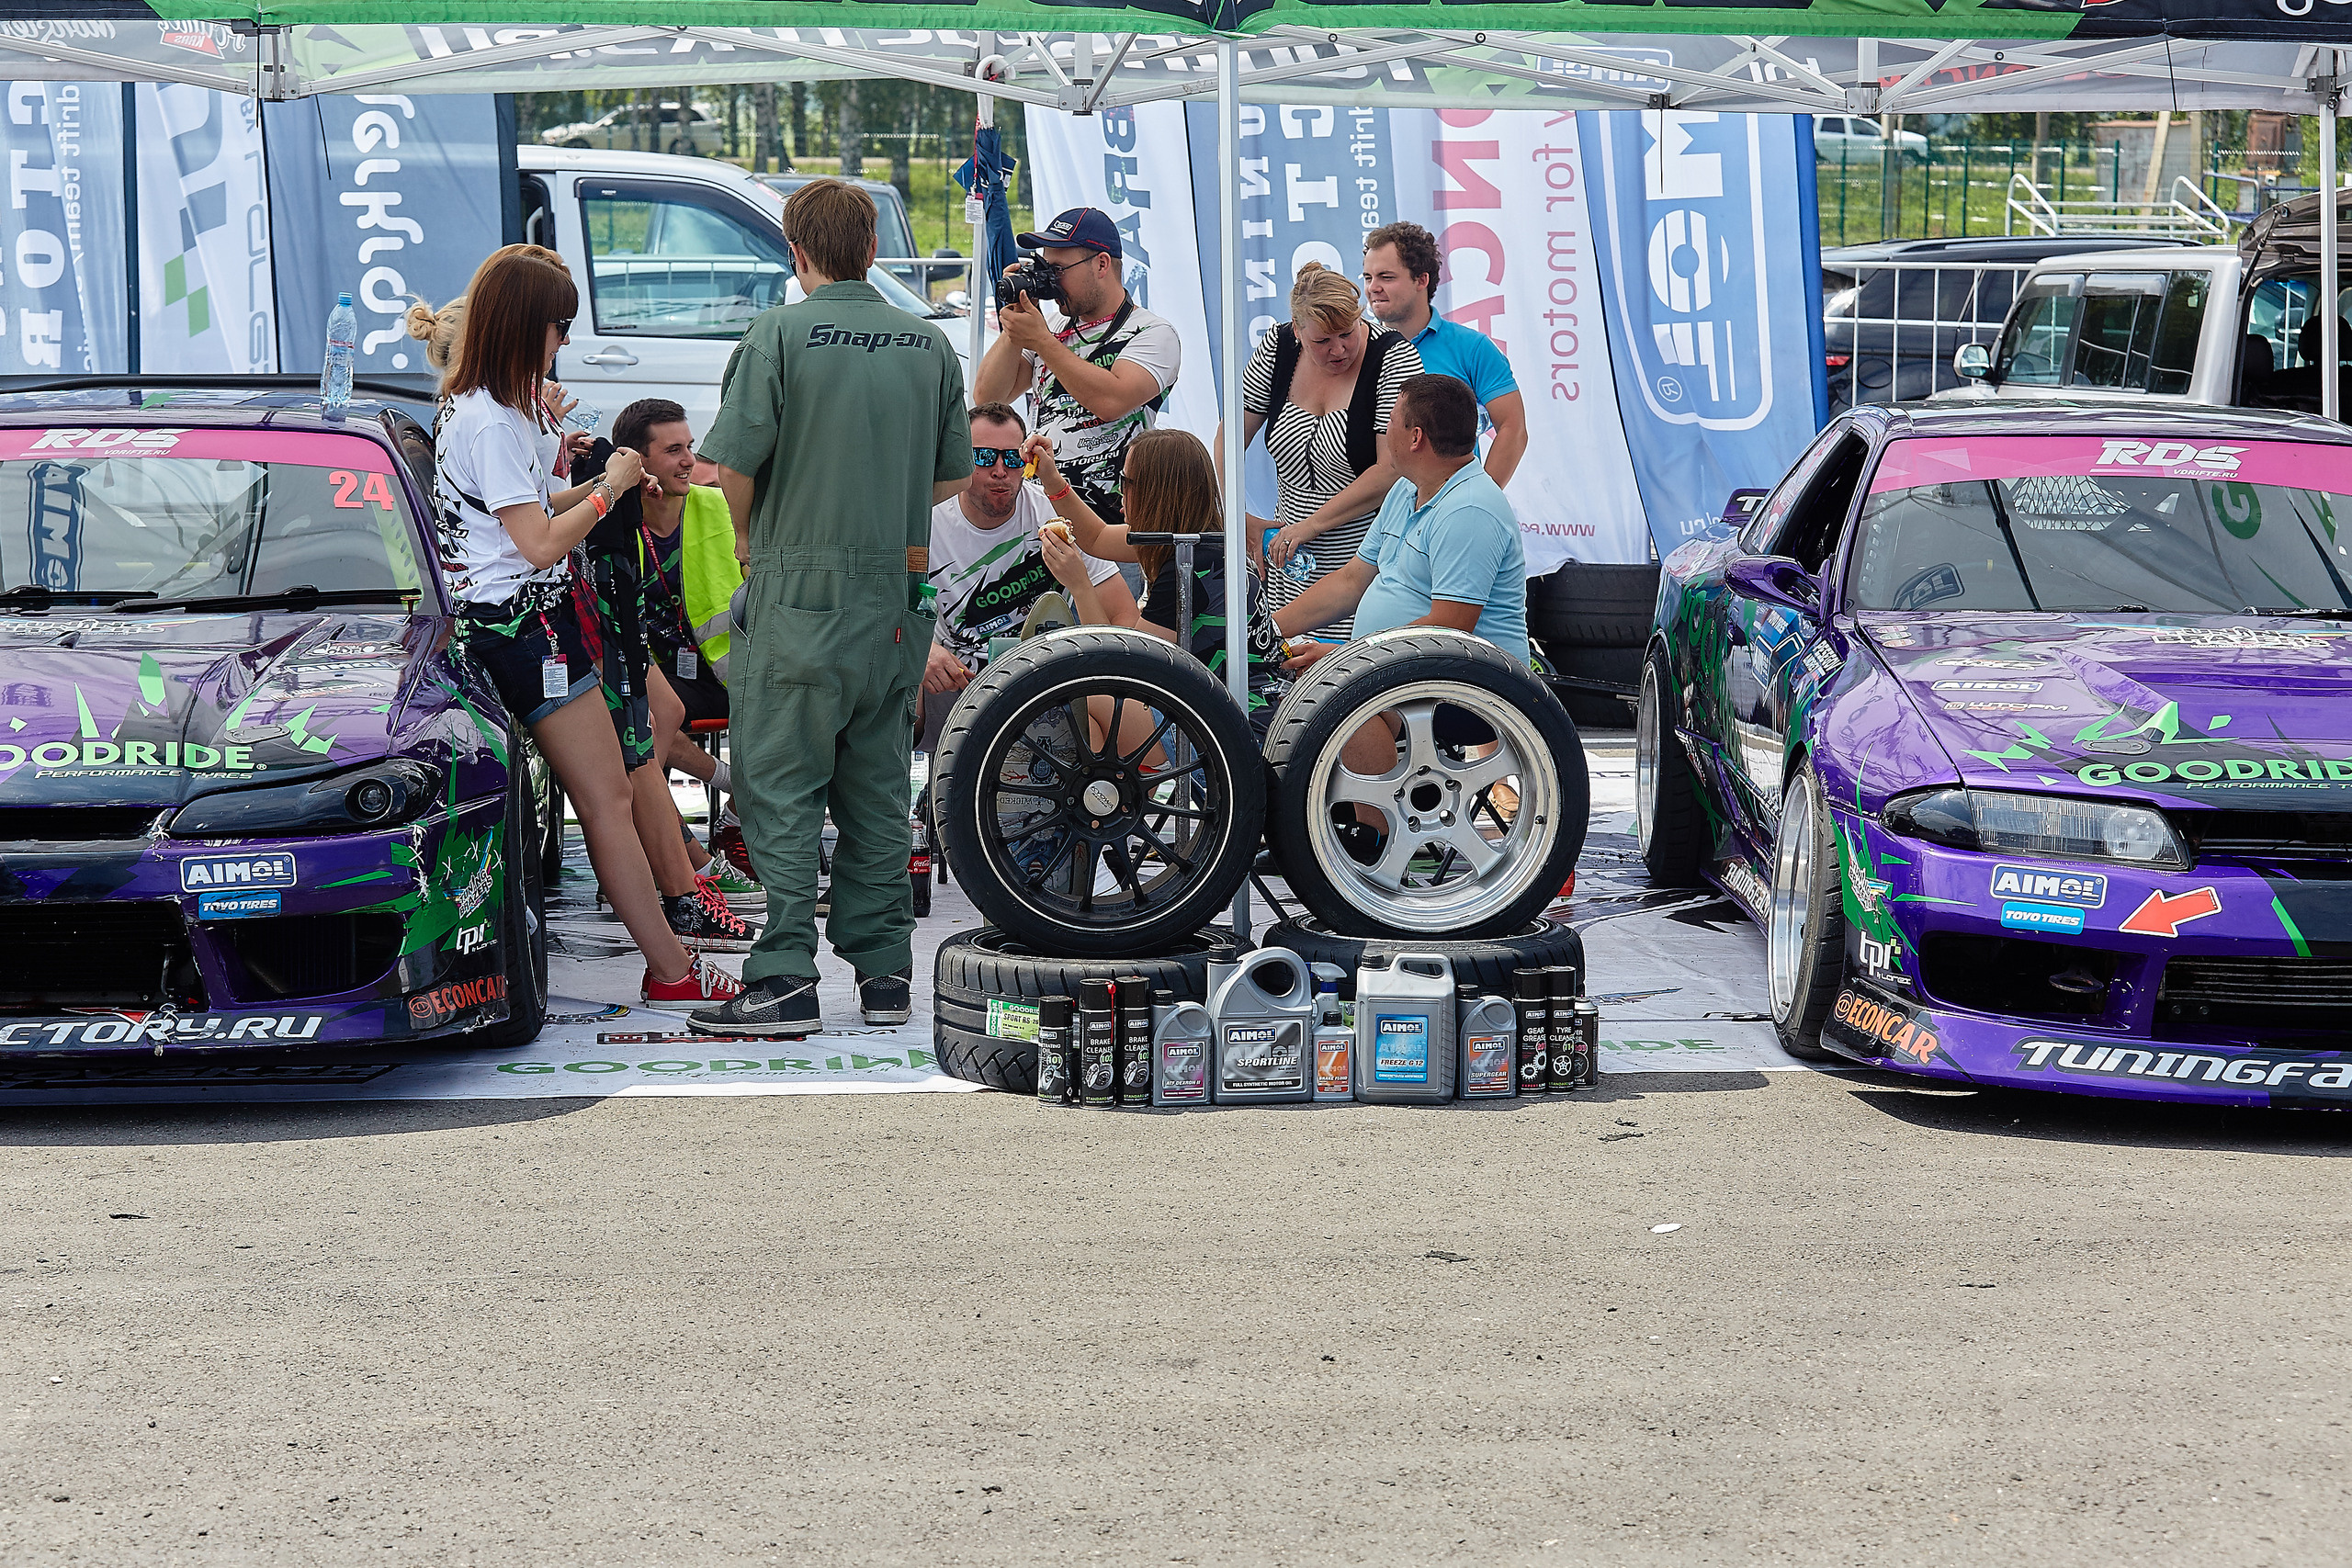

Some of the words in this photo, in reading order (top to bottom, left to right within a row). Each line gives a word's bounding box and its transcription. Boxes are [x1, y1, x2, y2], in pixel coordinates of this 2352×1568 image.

[805, 323, 933, 353] Snap-on
[29, 428, 194, 450] RDS
[104, 448, 172, 457] VDRIFTE.RU
[2096, 441, 2251, 472] RDS
[2172, 469, 2240, 479] VDRIFTE.RU
[329, 471, 395, 511] 24
[976, 565, 1046, 608] GOODRIDE
[979, 615, 1011, 634] AIMOL
[297, 662, 389, 672] AIMOL
[1936, 682, 2038, 691] AIMOL
[35, 769, 182, 779] PERFORMANCE
[190, 772, 254, 781] TYRES
[2186, 782, 2331, 790] PERFORMANCE
[187, 860, 291, 886] AIMOL
[1994, 872, 2102, 904] AIMOL
[203, 901, 238, 912] TOYO
[240, 898, 278, 910] TIRES
[2005, 908, 2041, 922] TOYO
[2043, 910, 2082, 927] TIRES
[1003, 1012, 1022, 1023] SPORT
[1130, 1020, 1148, 1028] AIMOL
[1383, 1022, 1423, 1033] AIMOL
[1229, 1029, 1275, 1042] AIMOL
[1846, 998, 1939, 1064] ECONCAR
[1086, 1046, 1114, 1055] CLEANER
[1169, 1047, 1199, 1056] AIMOL
[1474, 1042, 1503, 1050] AIMOL
[1237, 1056, 1298, 1067] SPORTLINE
